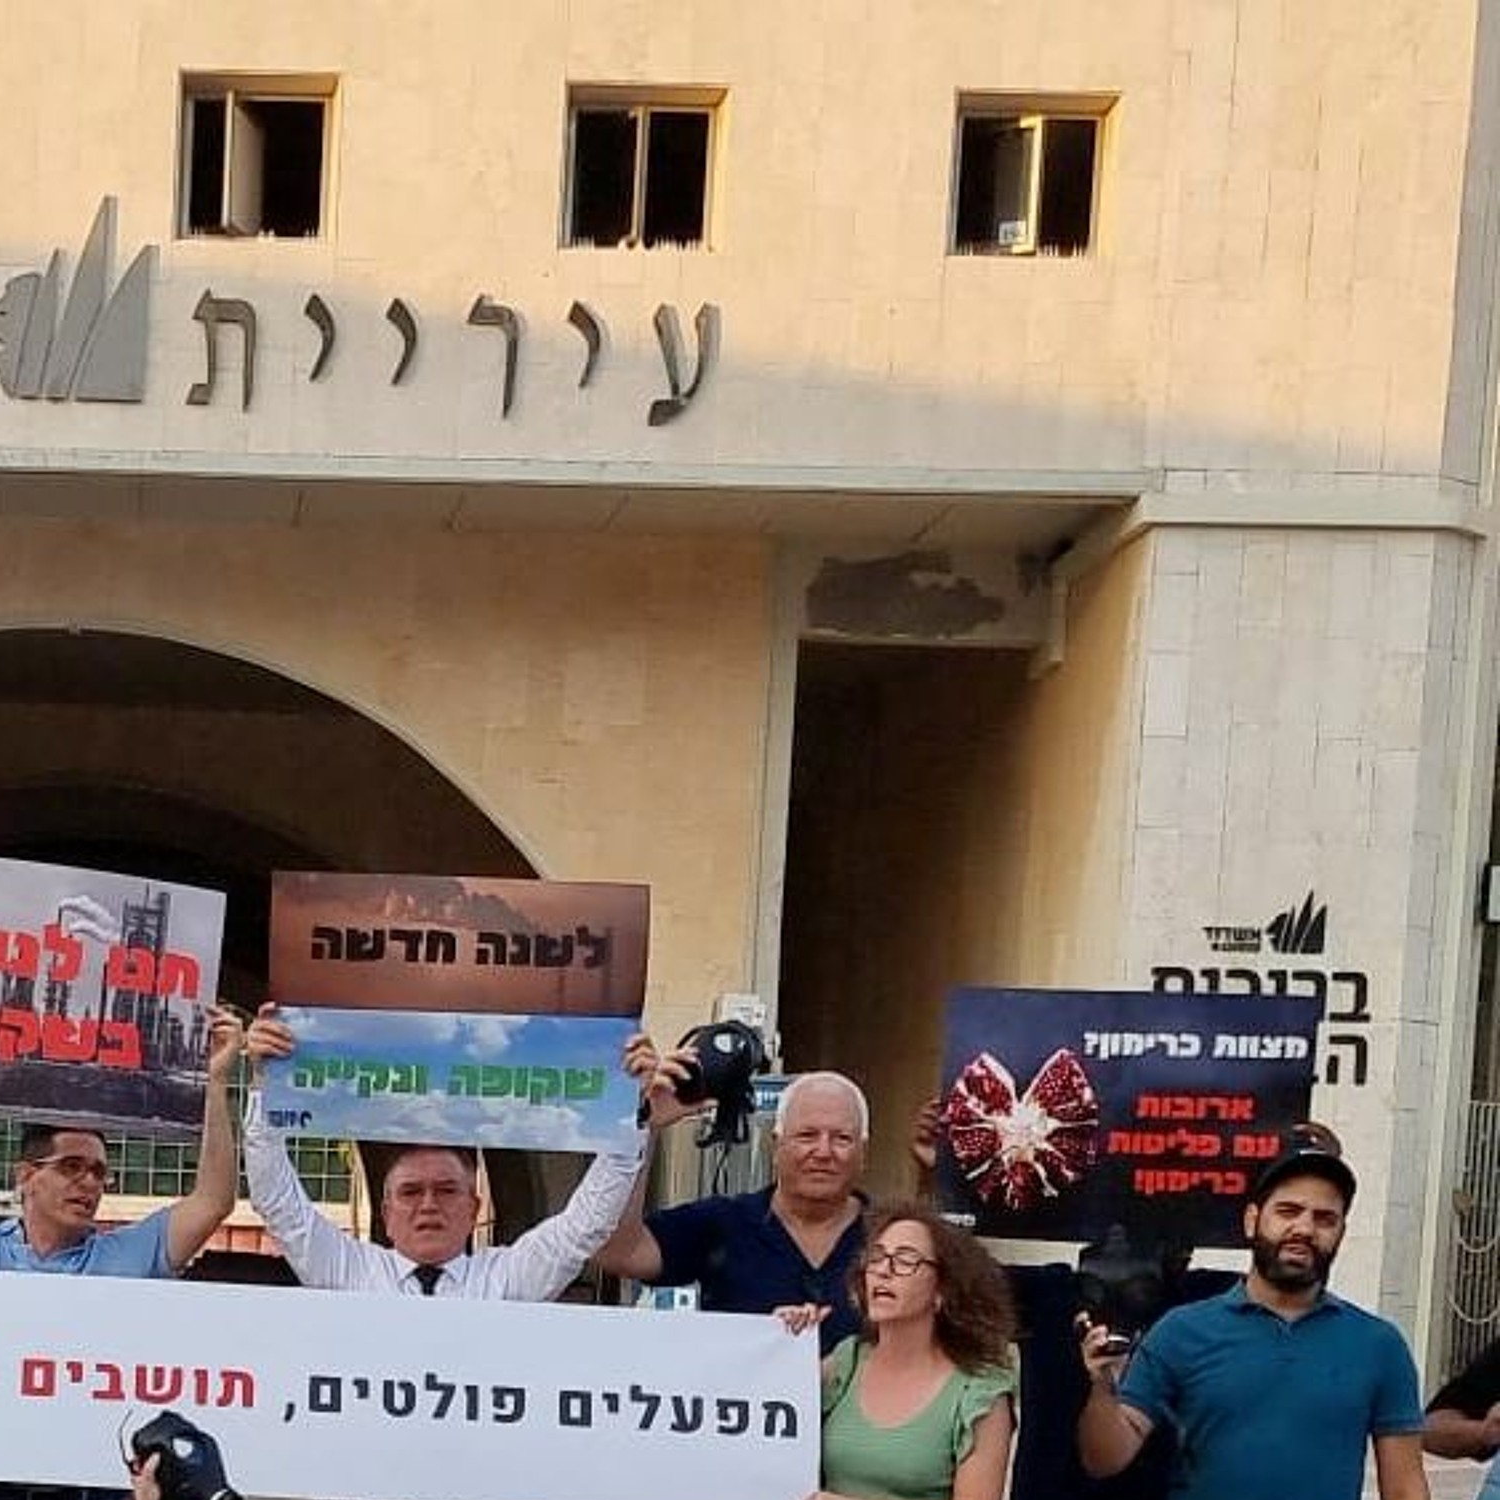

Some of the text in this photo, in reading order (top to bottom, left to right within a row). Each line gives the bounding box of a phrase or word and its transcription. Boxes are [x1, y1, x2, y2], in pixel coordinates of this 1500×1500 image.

[185, 287, 720, 427] עיריית
[310, 925, 612, 969] לשנה חדשה
[1083, 1032, 1202, 1061] כרימון?
[449, 1063, 608, 1105] שקופה
[1135, 1094, 1255, 1121] ארובות
[1108, 1129, 1280, 1158] עם פליטות
[20, 1356, 256, 1409] תושבים
[282, 1372, 527, 1424] פולטים,
[558, 1384, 800, 1440] מפעלים
